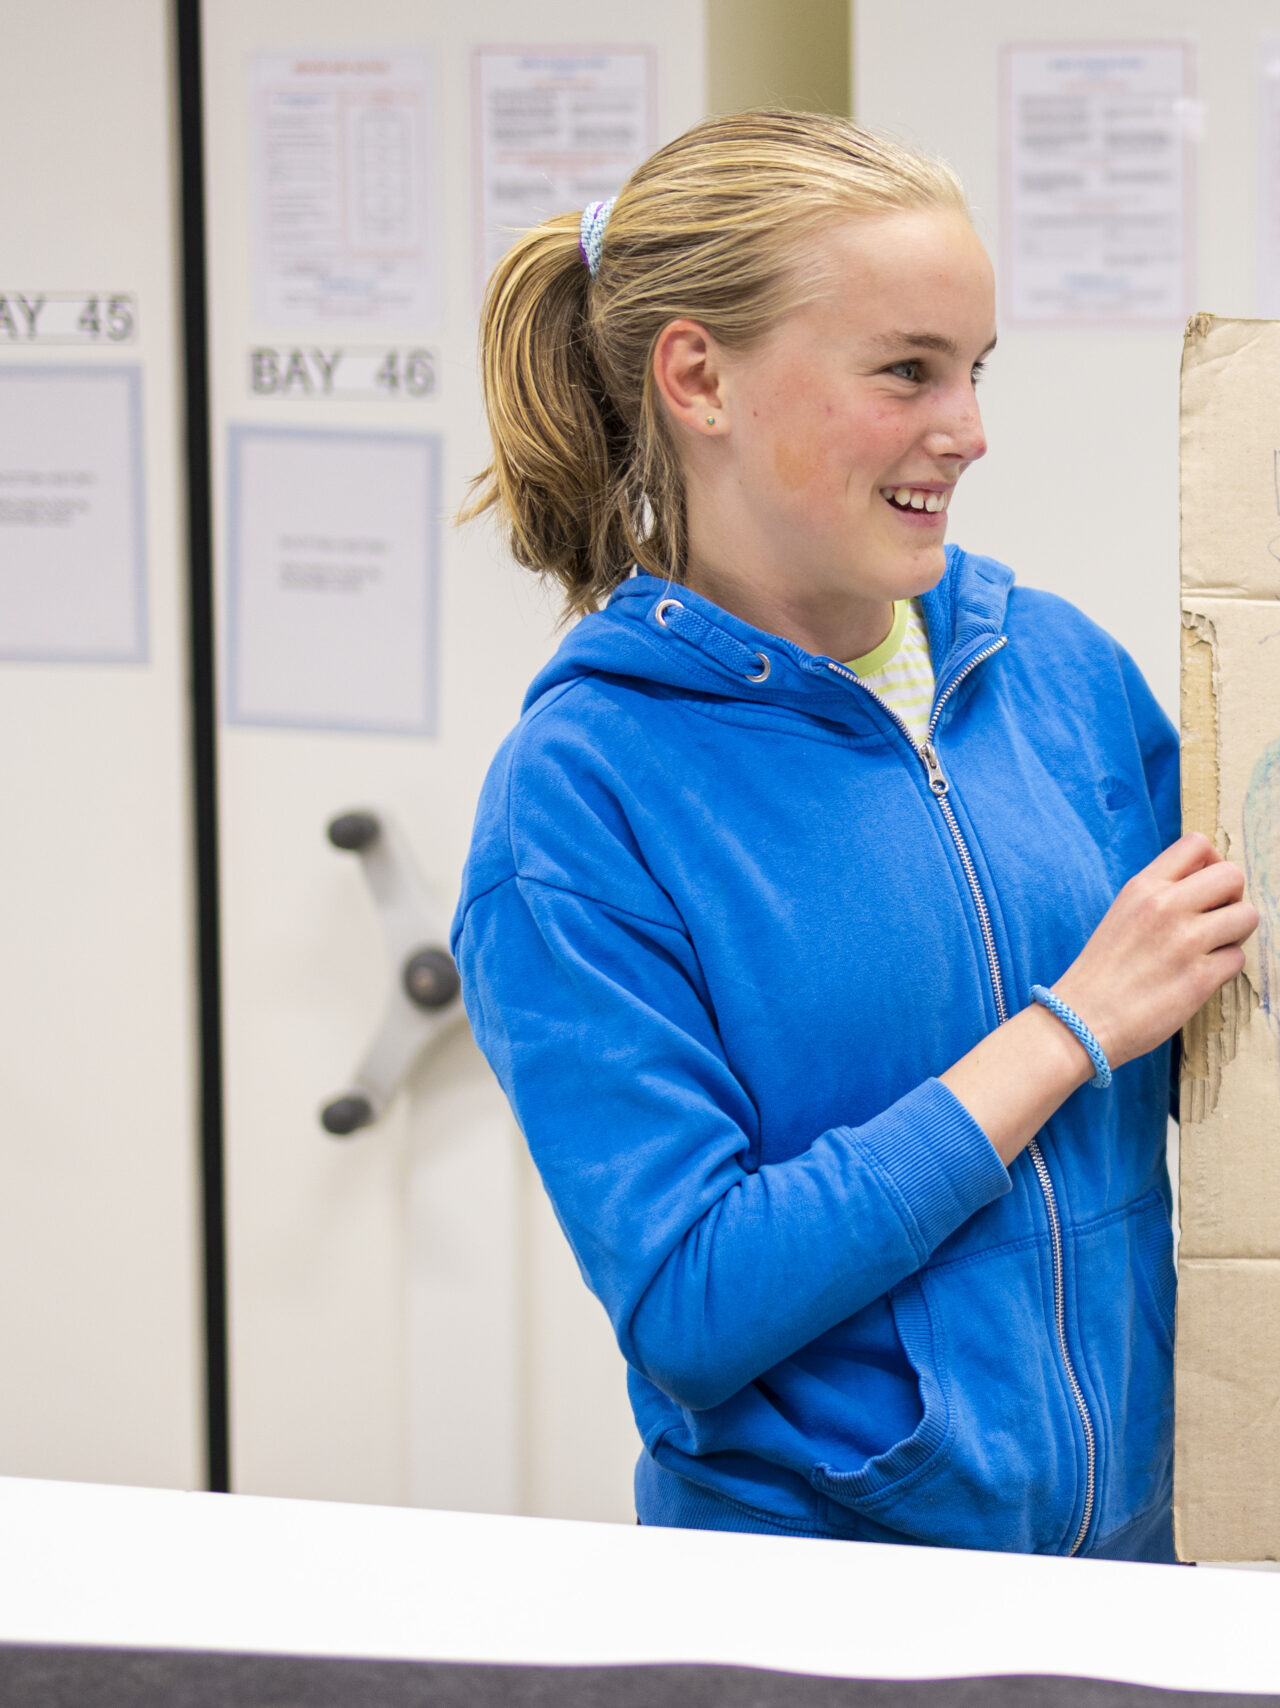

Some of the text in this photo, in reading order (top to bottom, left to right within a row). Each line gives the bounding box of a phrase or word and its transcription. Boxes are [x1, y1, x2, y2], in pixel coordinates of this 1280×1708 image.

[0, 293, 134, 341] AY 45
[250, 347, 437, 397] BAY 46
